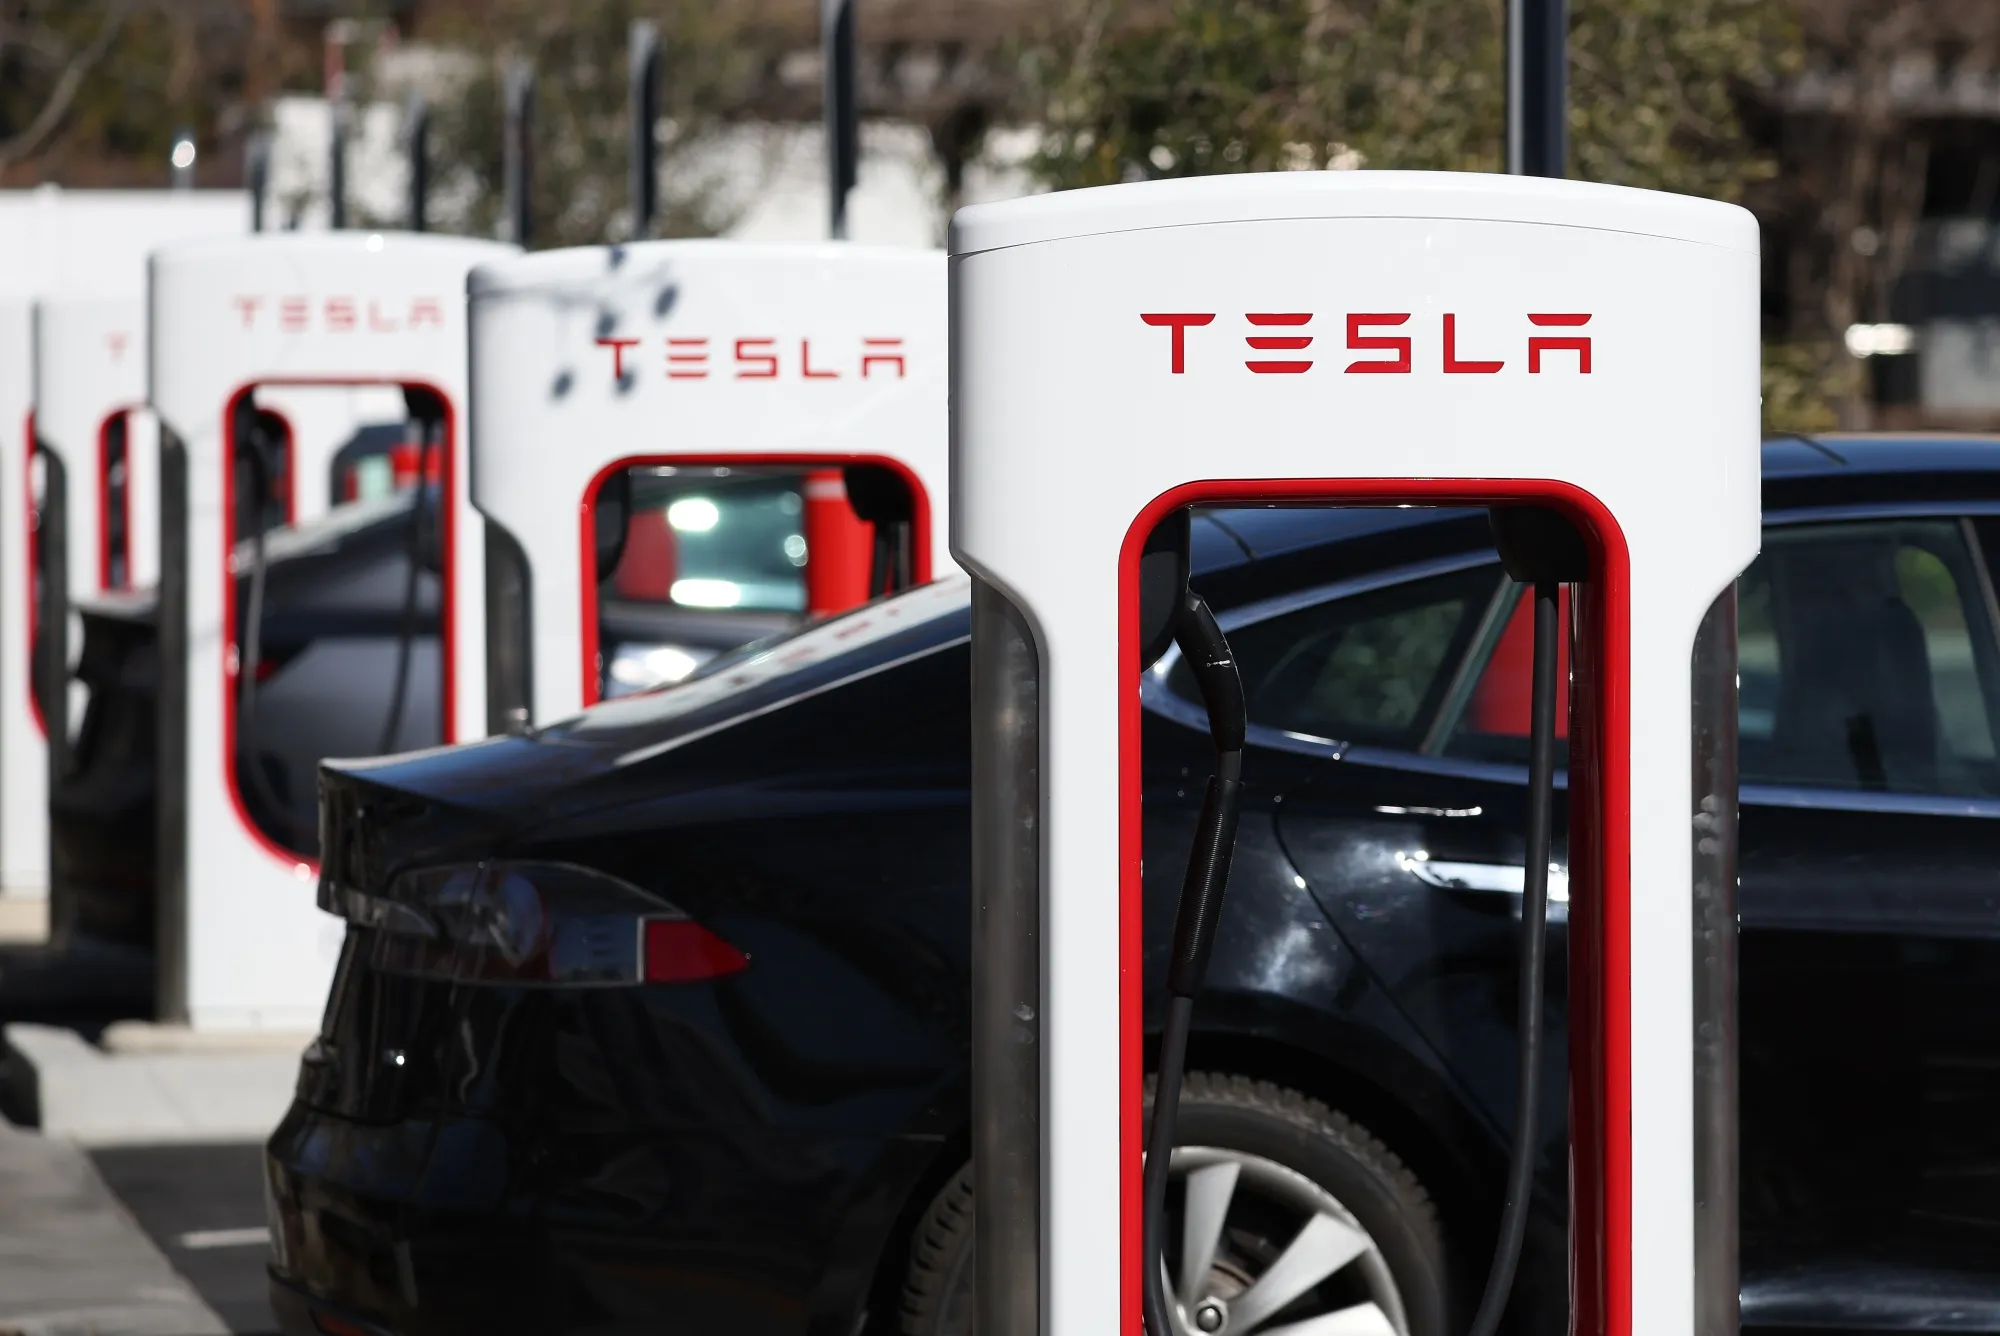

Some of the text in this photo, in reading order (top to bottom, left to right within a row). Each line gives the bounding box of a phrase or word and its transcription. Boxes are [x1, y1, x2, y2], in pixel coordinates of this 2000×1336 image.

[233, 296, 444, 331] TESLA
[594, 337, 906, 379] TESLA
[1140, 312, 1592, 374] TESLA
